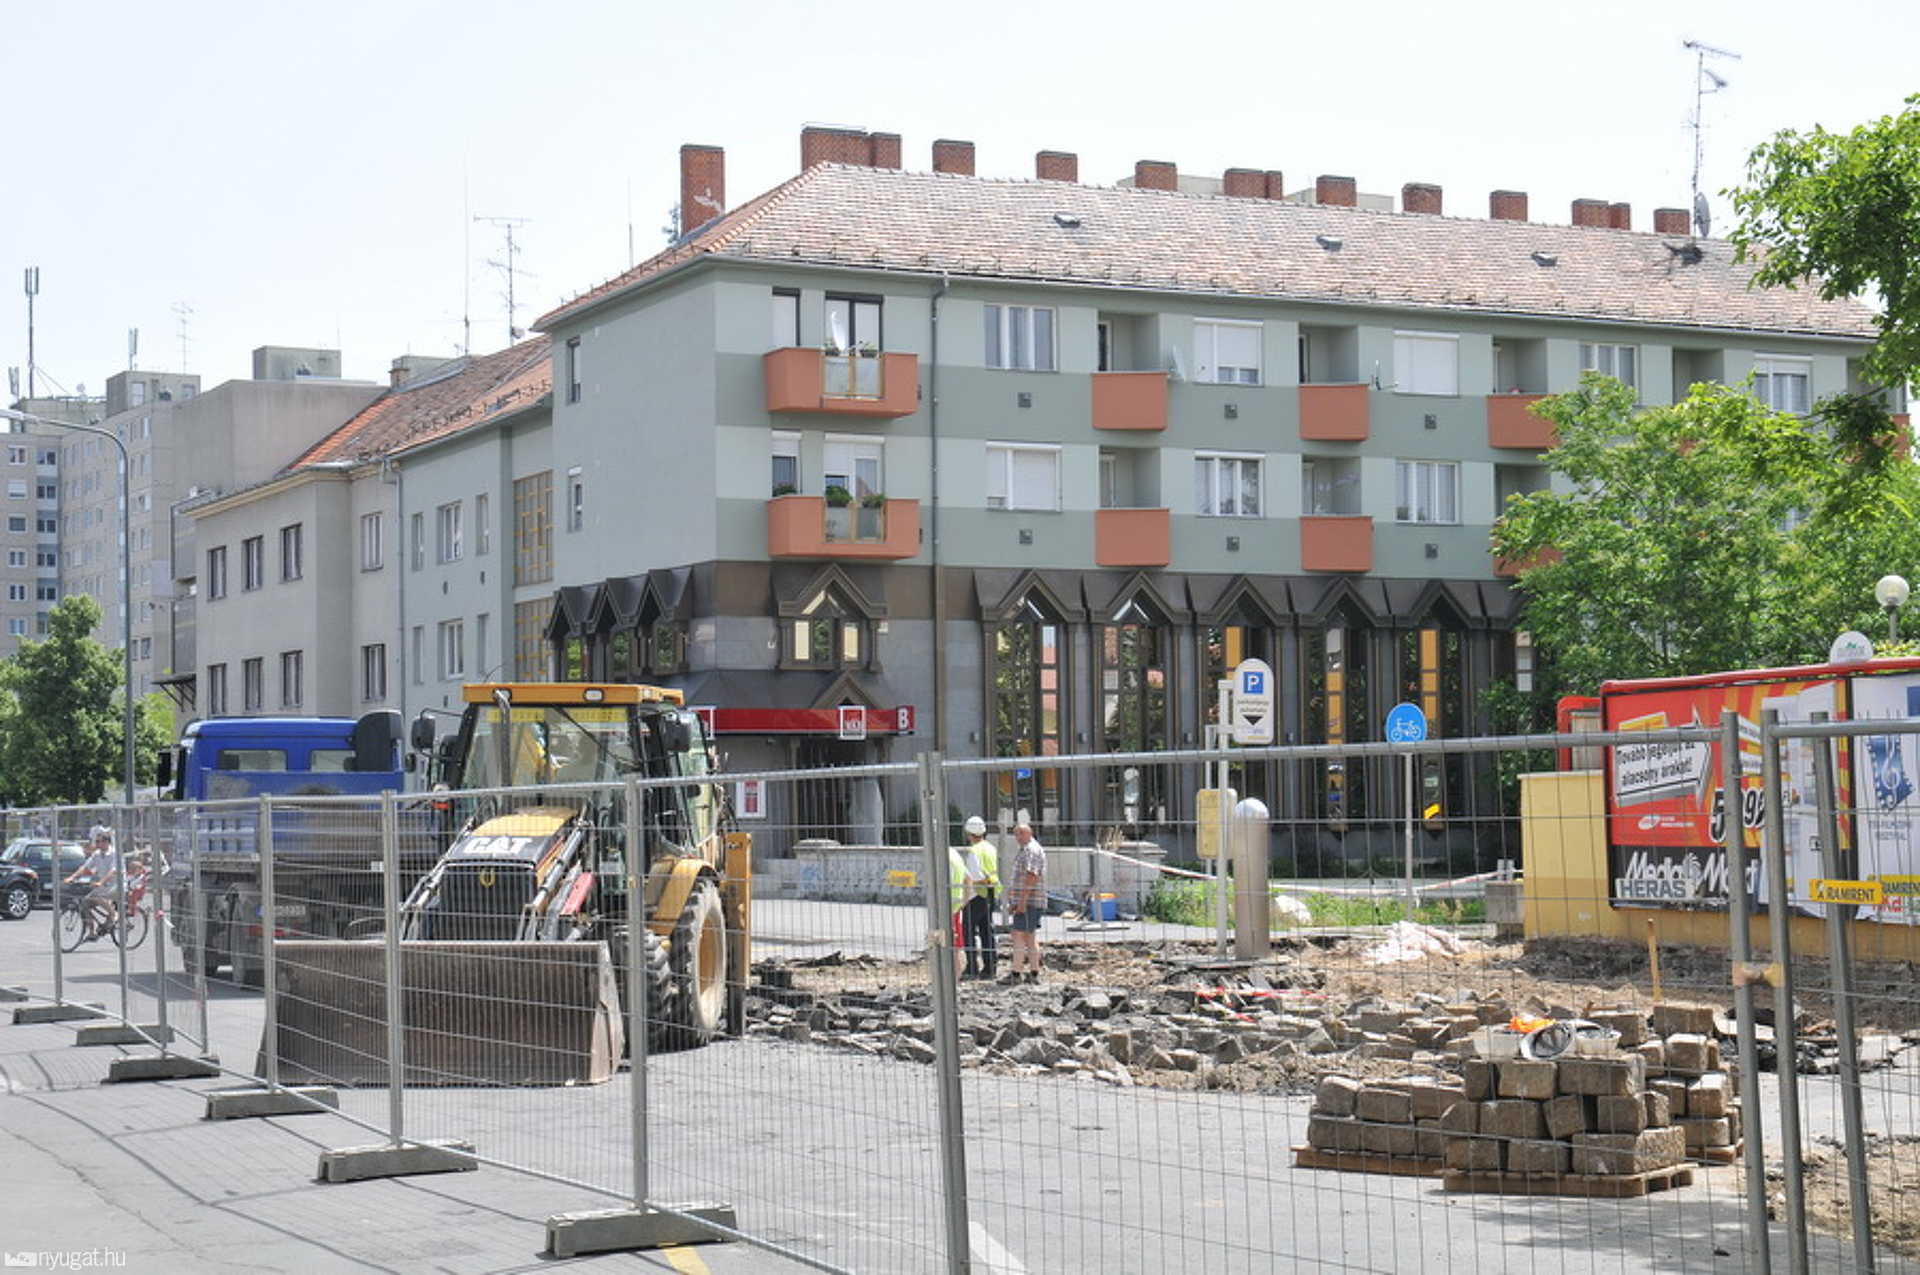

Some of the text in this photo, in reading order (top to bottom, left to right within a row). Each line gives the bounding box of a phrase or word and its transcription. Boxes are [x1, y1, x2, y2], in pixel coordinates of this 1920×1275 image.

[897, 708, 909, 729] B
[463, 836, 533, 855] CAT
[1620, 880, 1687, 898] HERAS
